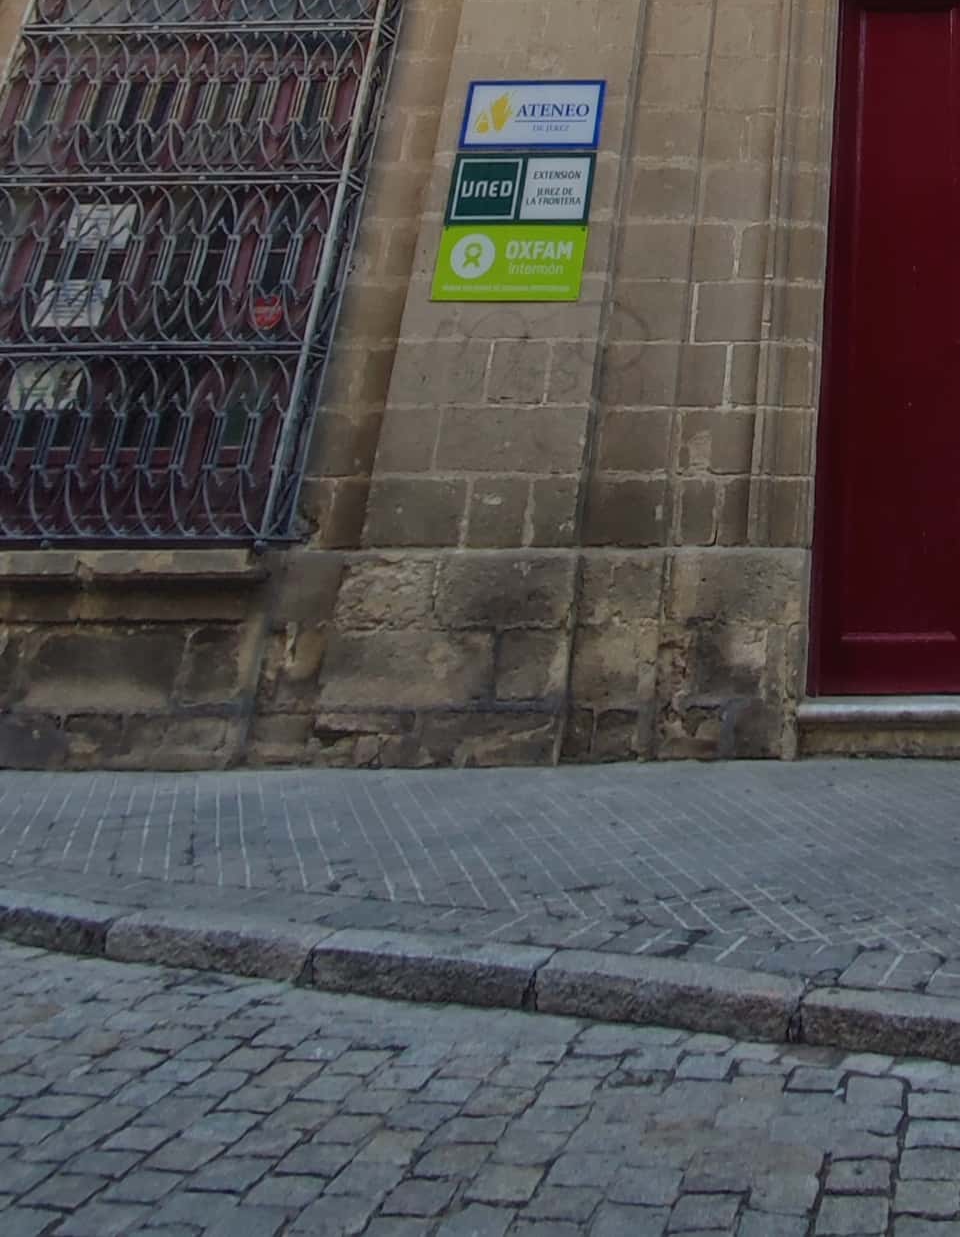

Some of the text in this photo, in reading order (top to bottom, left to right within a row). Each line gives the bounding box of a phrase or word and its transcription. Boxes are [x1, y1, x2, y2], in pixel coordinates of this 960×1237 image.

[516, 103, 590, 118] ATENEO
[460, 180, 513, 198] UNED
[536, 186, 574, 197] JEREZ DE
[526, 196, 582, 207] LA FRONTERA
[505, 240, 574, 260] OXFAM
